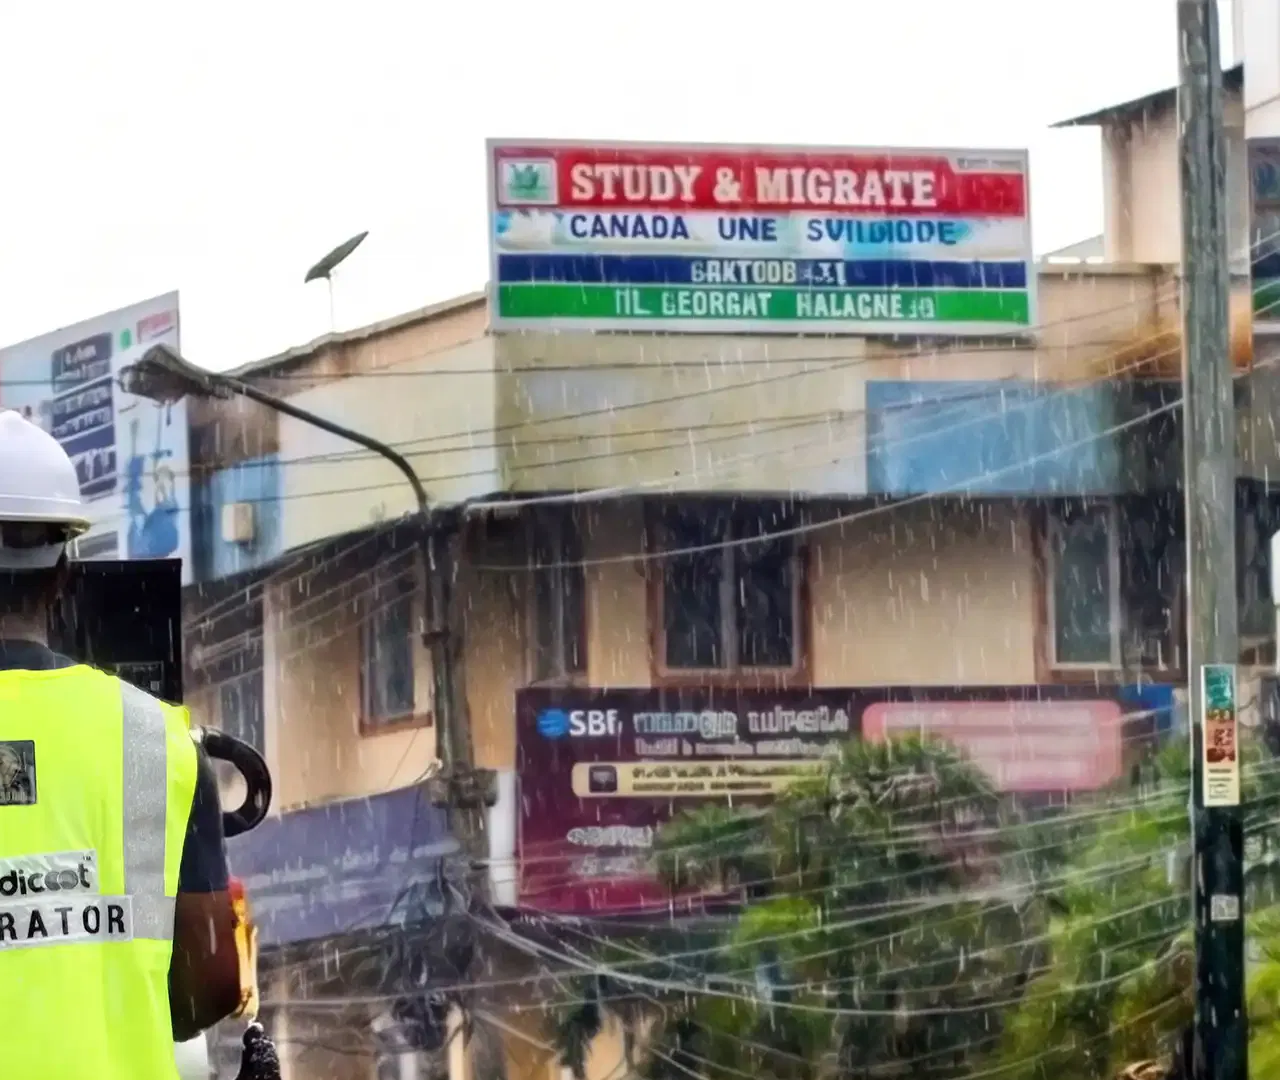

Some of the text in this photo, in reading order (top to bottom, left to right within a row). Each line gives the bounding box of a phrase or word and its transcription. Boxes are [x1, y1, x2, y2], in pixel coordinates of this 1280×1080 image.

[571, 164, 938, 207] STUDY & MIGRATE
[570, 214, 690, 240] CANADA
